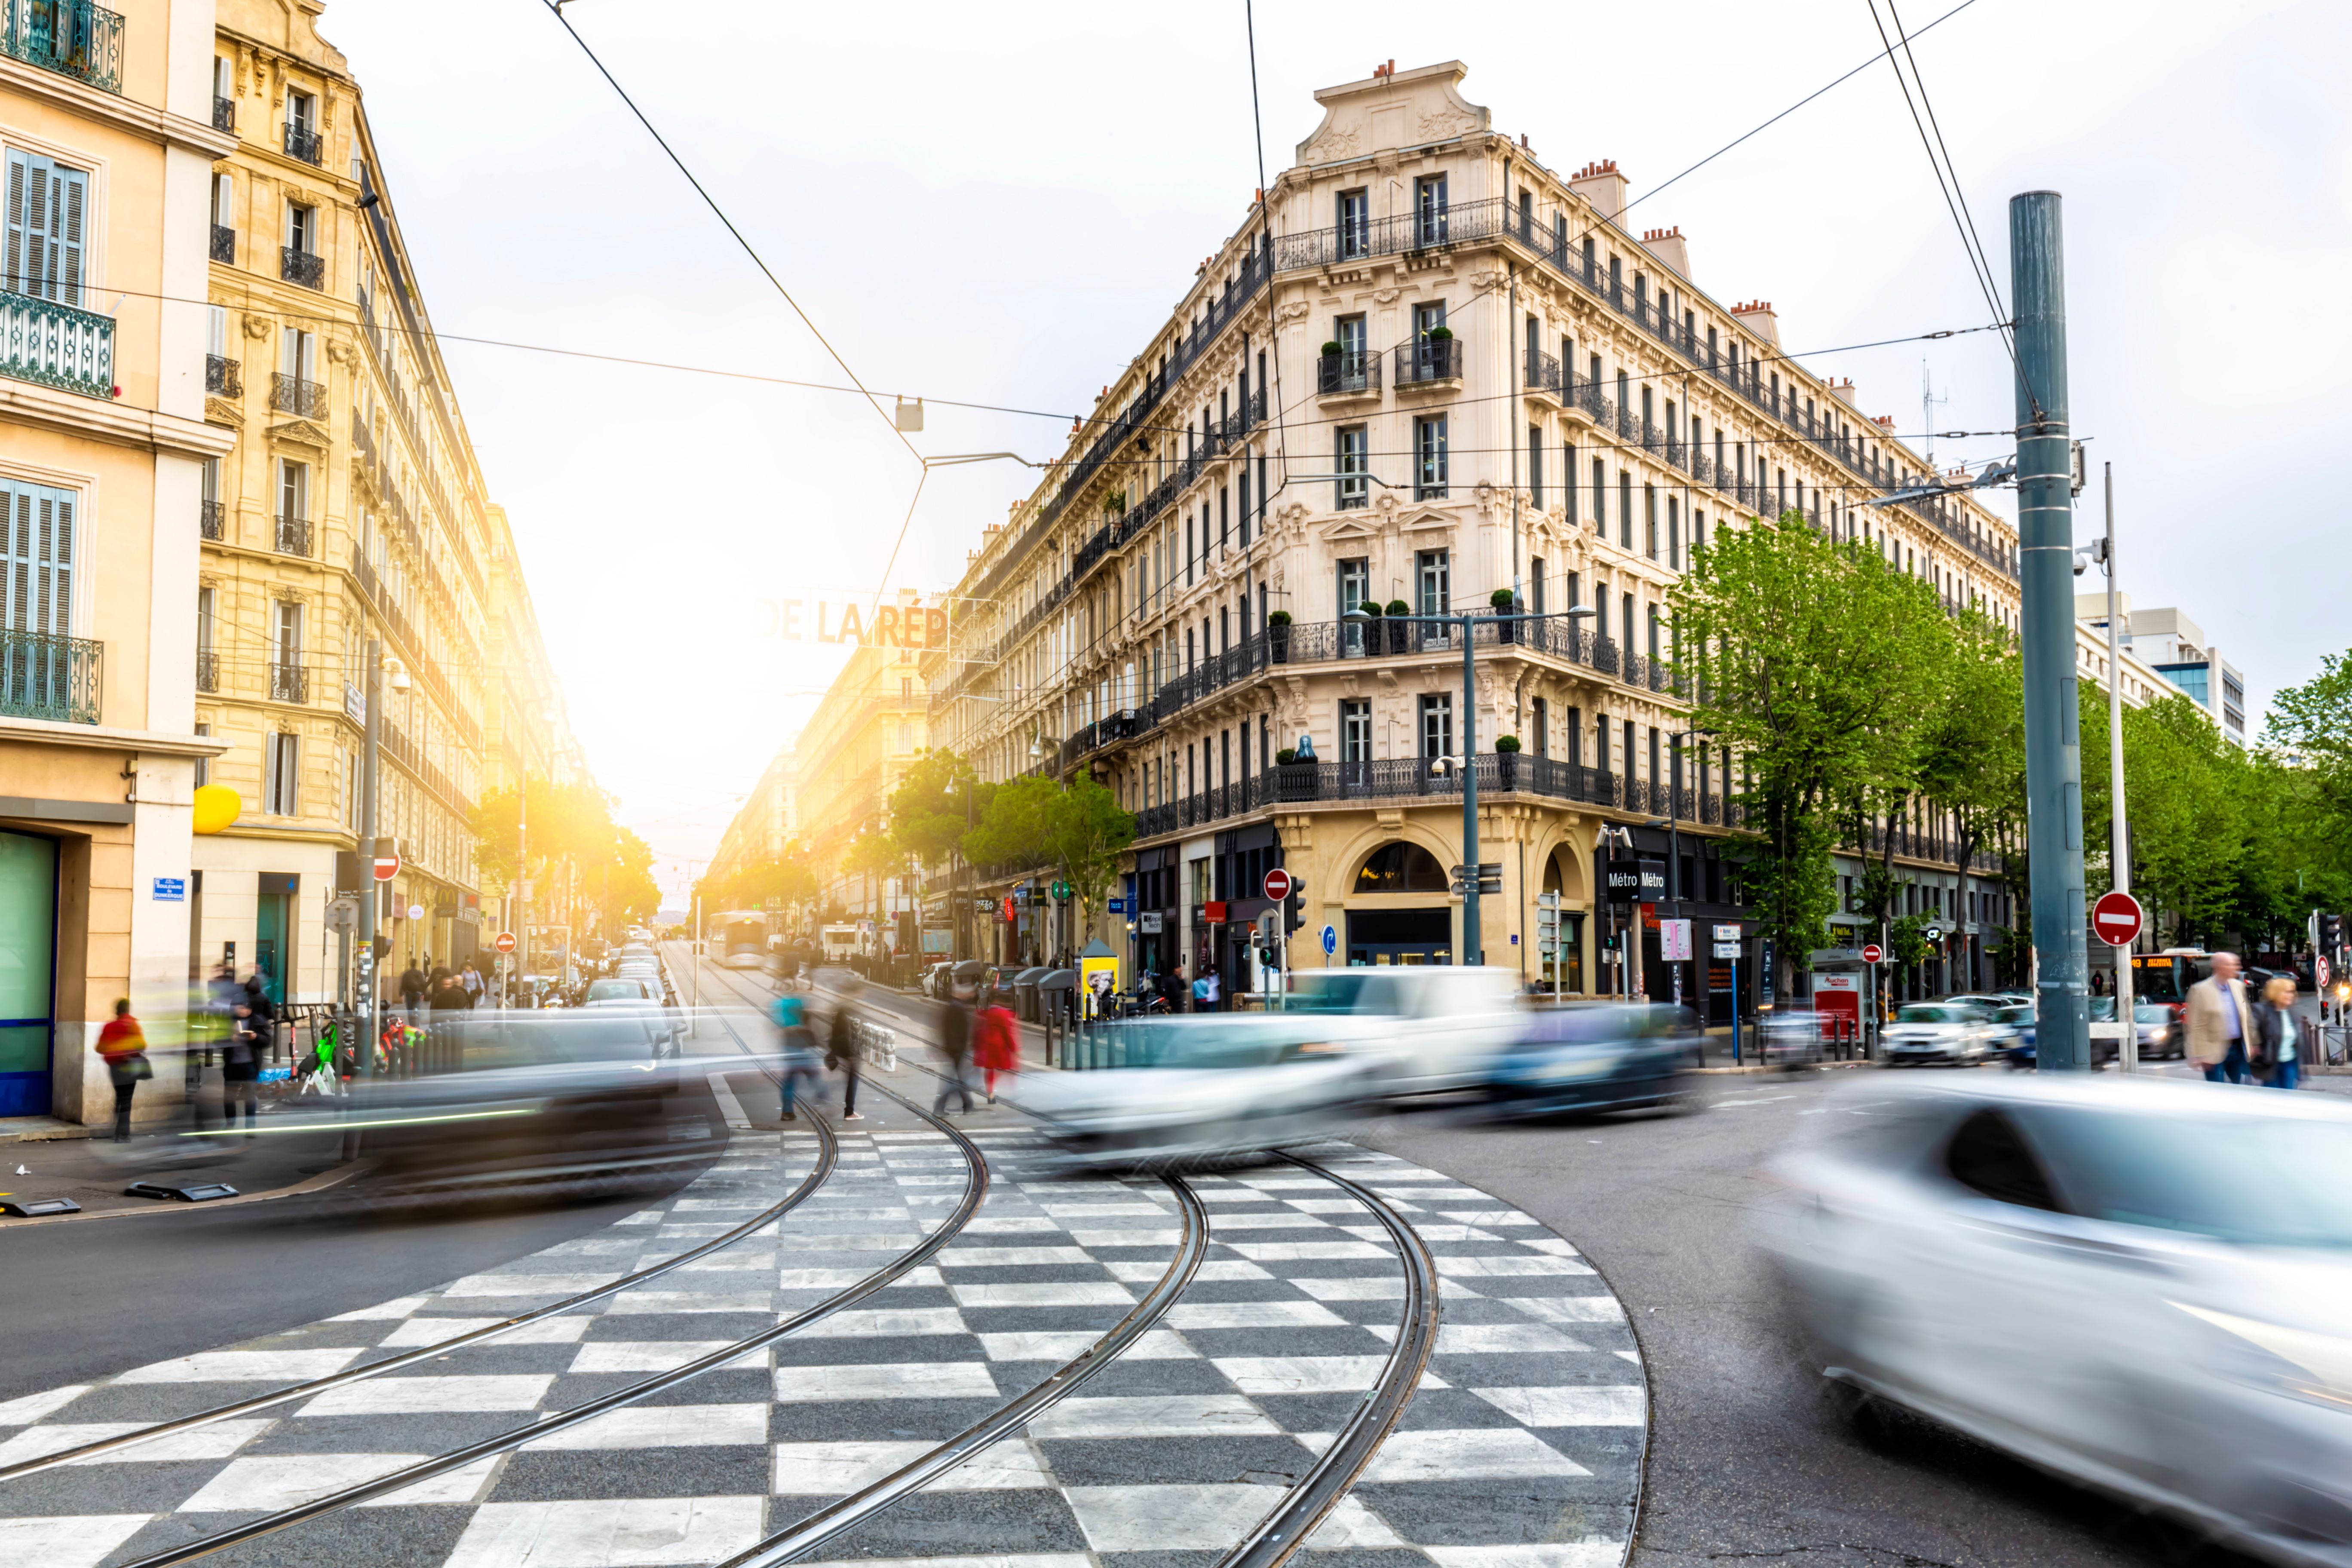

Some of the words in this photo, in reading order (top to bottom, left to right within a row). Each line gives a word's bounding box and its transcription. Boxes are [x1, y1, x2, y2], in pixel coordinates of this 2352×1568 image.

[753, 598, 803, 641] DE
[818, 601, 865, 645] LA
[878, 598, 948, 648] RÉP
[1609, 872, 1637, 887] Métro
[1642, 872, 1663, 887] Métro
[1645, 918, 1661, 931] Orang
[2131, 959, 2141, 967] 49
